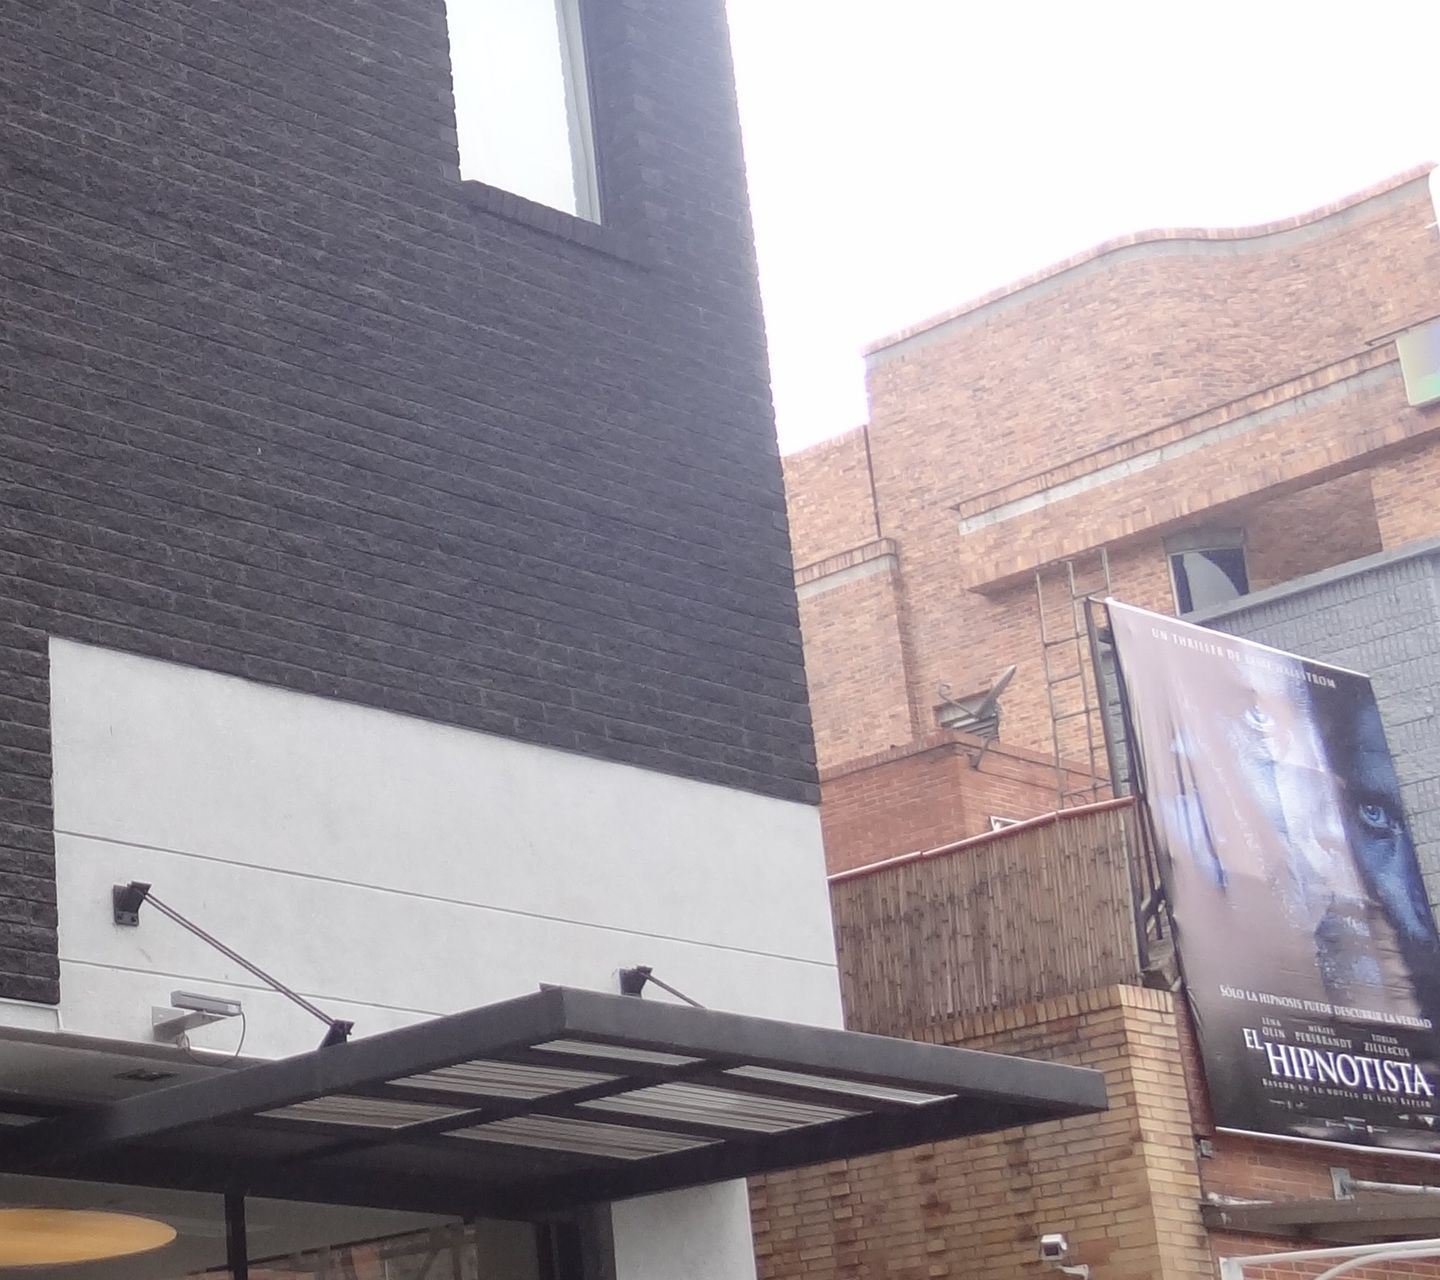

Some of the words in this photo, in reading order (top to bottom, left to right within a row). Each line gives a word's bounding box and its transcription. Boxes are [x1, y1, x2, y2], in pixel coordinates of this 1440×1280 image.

[1151, 627, 1169, 642] UN
[1173, 634, 1224, 657] THRILLER
[1246, 990, 1258, 1002] LA
[1259, 992, 1303, 1010] HIPNOSIS
[1304, 1000, 1334, 1016] PUEDE
[1334, 1005, 1383, 1022] DESCUBRIR
[1384, 1013, 1396, 1024] LA
[1396, 1014, 1433, 1029] VERDAD
[1243, 1028, 1265, 1050] EL
[1262, 1026, 1286, 1038] OLIN
[1264, 1042, 1435, 1097] HIPNOTISTA
